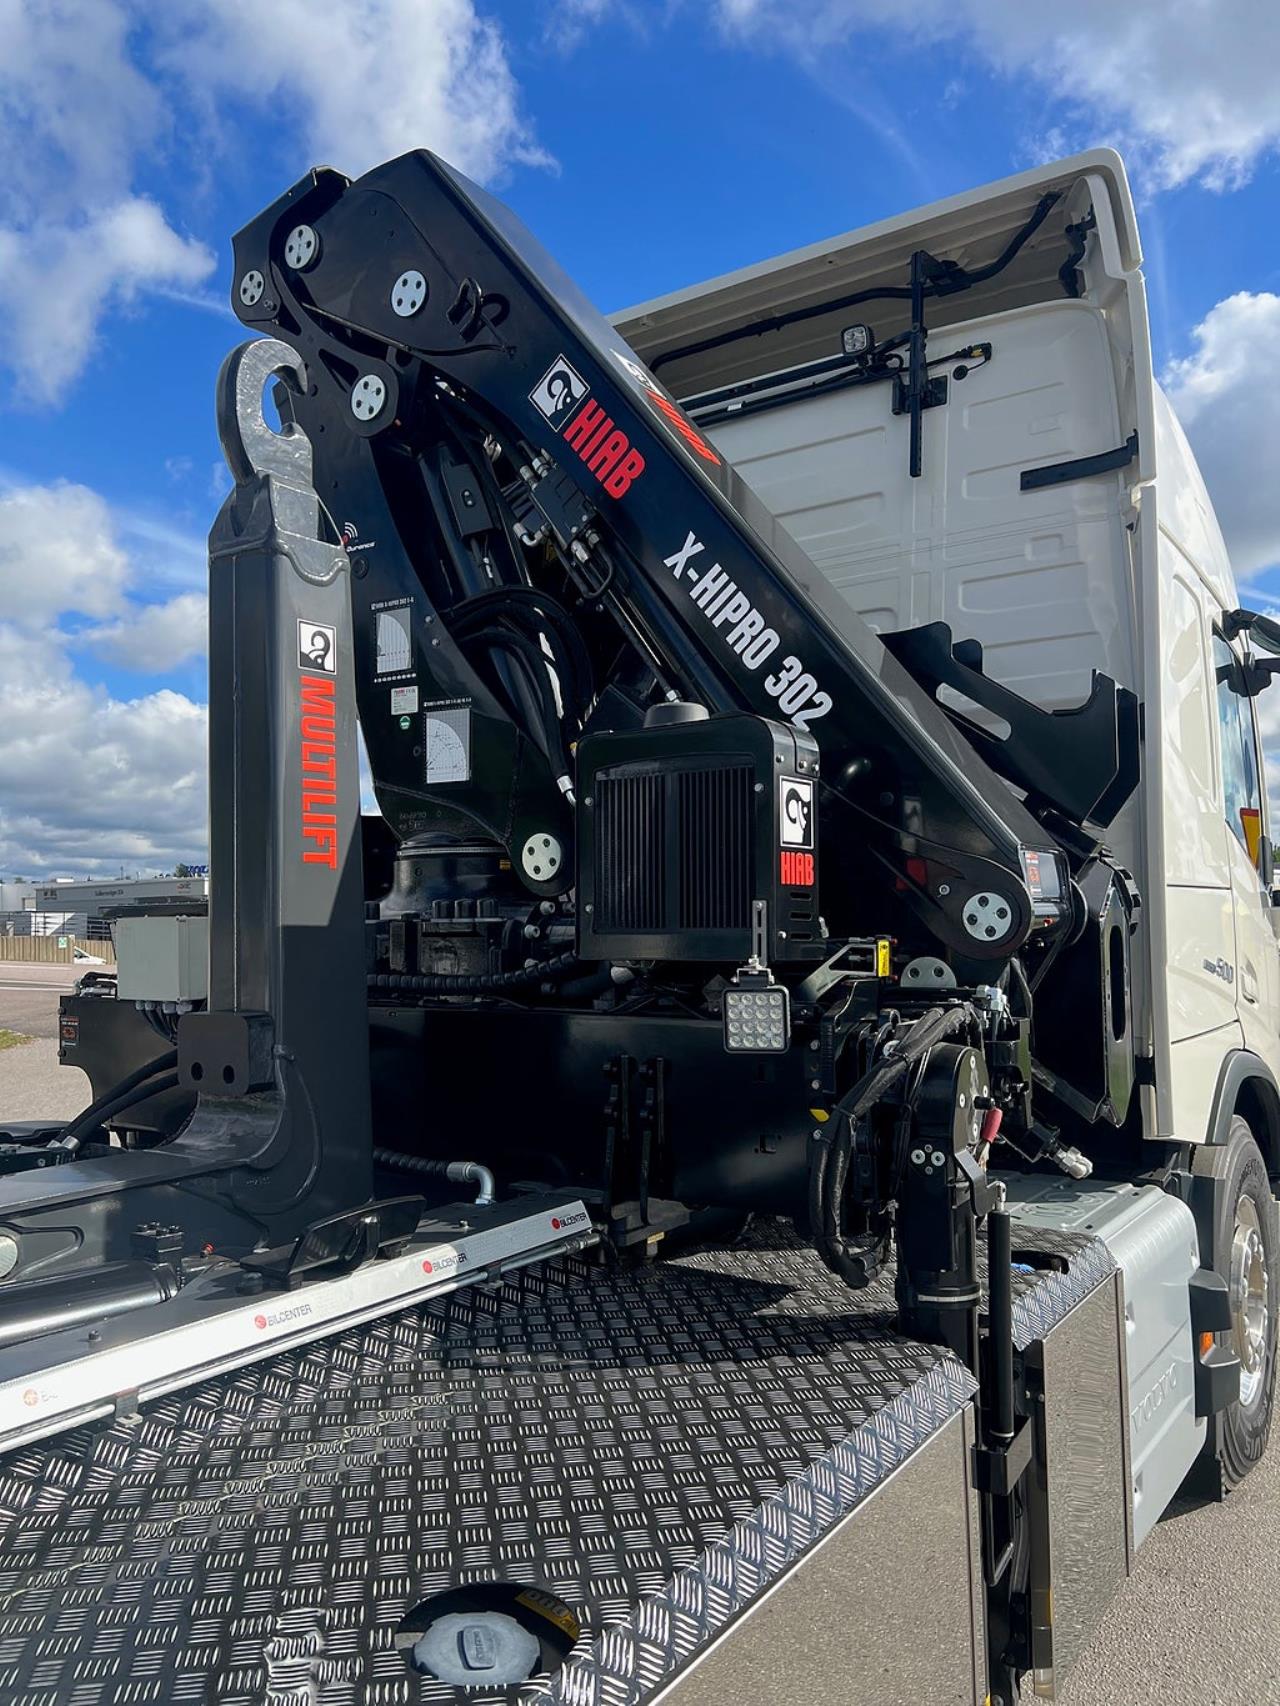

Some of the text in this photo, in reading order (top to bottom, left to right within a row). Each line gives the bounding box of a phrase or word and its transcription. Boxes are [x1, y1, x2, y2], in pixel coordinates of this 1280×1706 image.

[563, 398, 646, 500] HIAB
[663, 530, 833, 732] X-HIPRO 302
[301, 675, 337, 870] MULTILIFT
[780, 851, 814, 886] HIAB
[559, 1211, 587, 1228] BILCENTER
[432, 1252, 467, 1272] BILCENTER
[267, 1304, 312, 1326] BILCENTER
[1131, 1362, 1177, 1433] VOLVO
